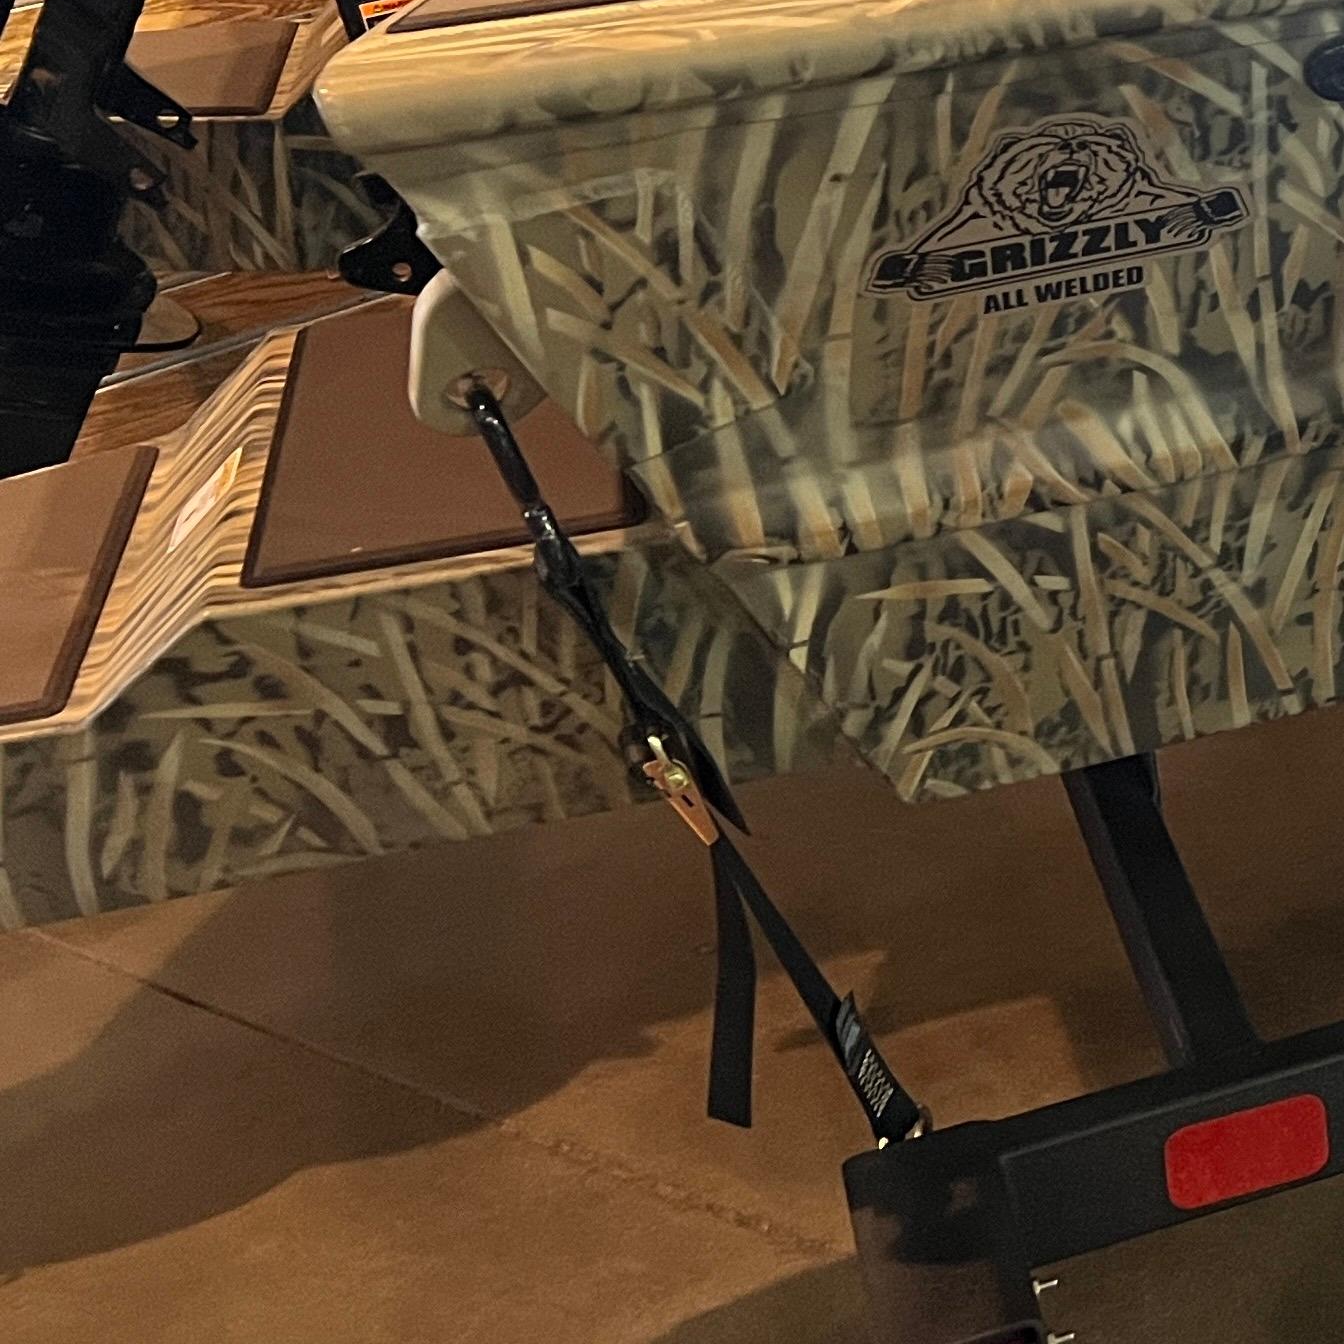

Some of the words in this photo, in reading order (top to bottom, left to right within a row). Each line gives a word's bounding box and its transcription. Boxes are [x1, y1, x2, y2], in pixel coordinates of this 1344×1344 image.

[950, 215, 1169, 282] GRIZZLY
[983, 288, 1028, 314] ALL
[1035, 266, 1143, 303] WELDED
